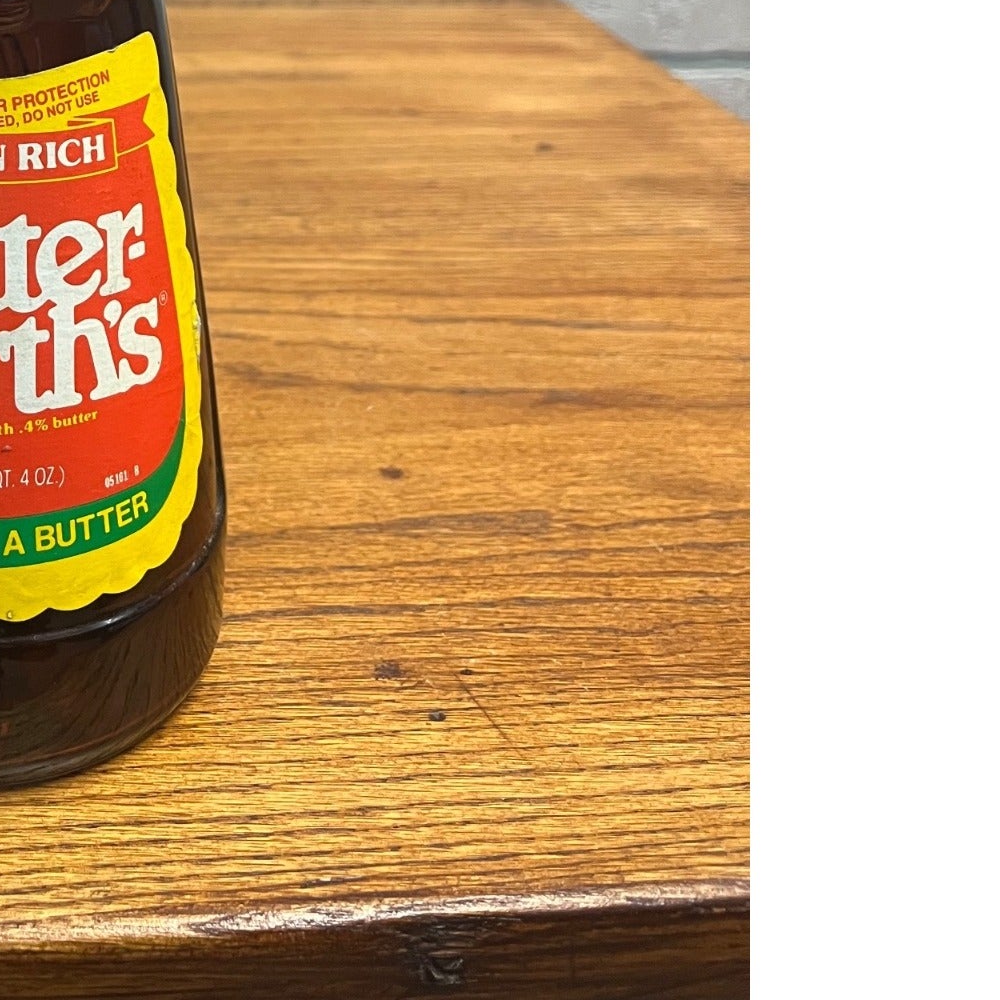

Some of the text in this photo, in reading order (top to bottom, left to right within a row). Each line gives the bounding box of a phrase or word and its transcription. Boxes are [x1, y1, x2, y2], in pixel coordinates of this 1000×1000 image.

[11, 69, 110, 111] PROTECTION
[22, 108, 43, 124] DO
[46, 99, 72, 118] NOT
[75, 90, 100, 109] USE
[17, 133, 106, 171] RICH
[19, 418, 49, 435] .4%
[52, 410, 98, 429] butter
[20, 469, 30, 487] 4
[34, 465, 65, 489] OZ.)
[2, 535, 25, 556] A
[34, 490, 149, 553] BUTTER
